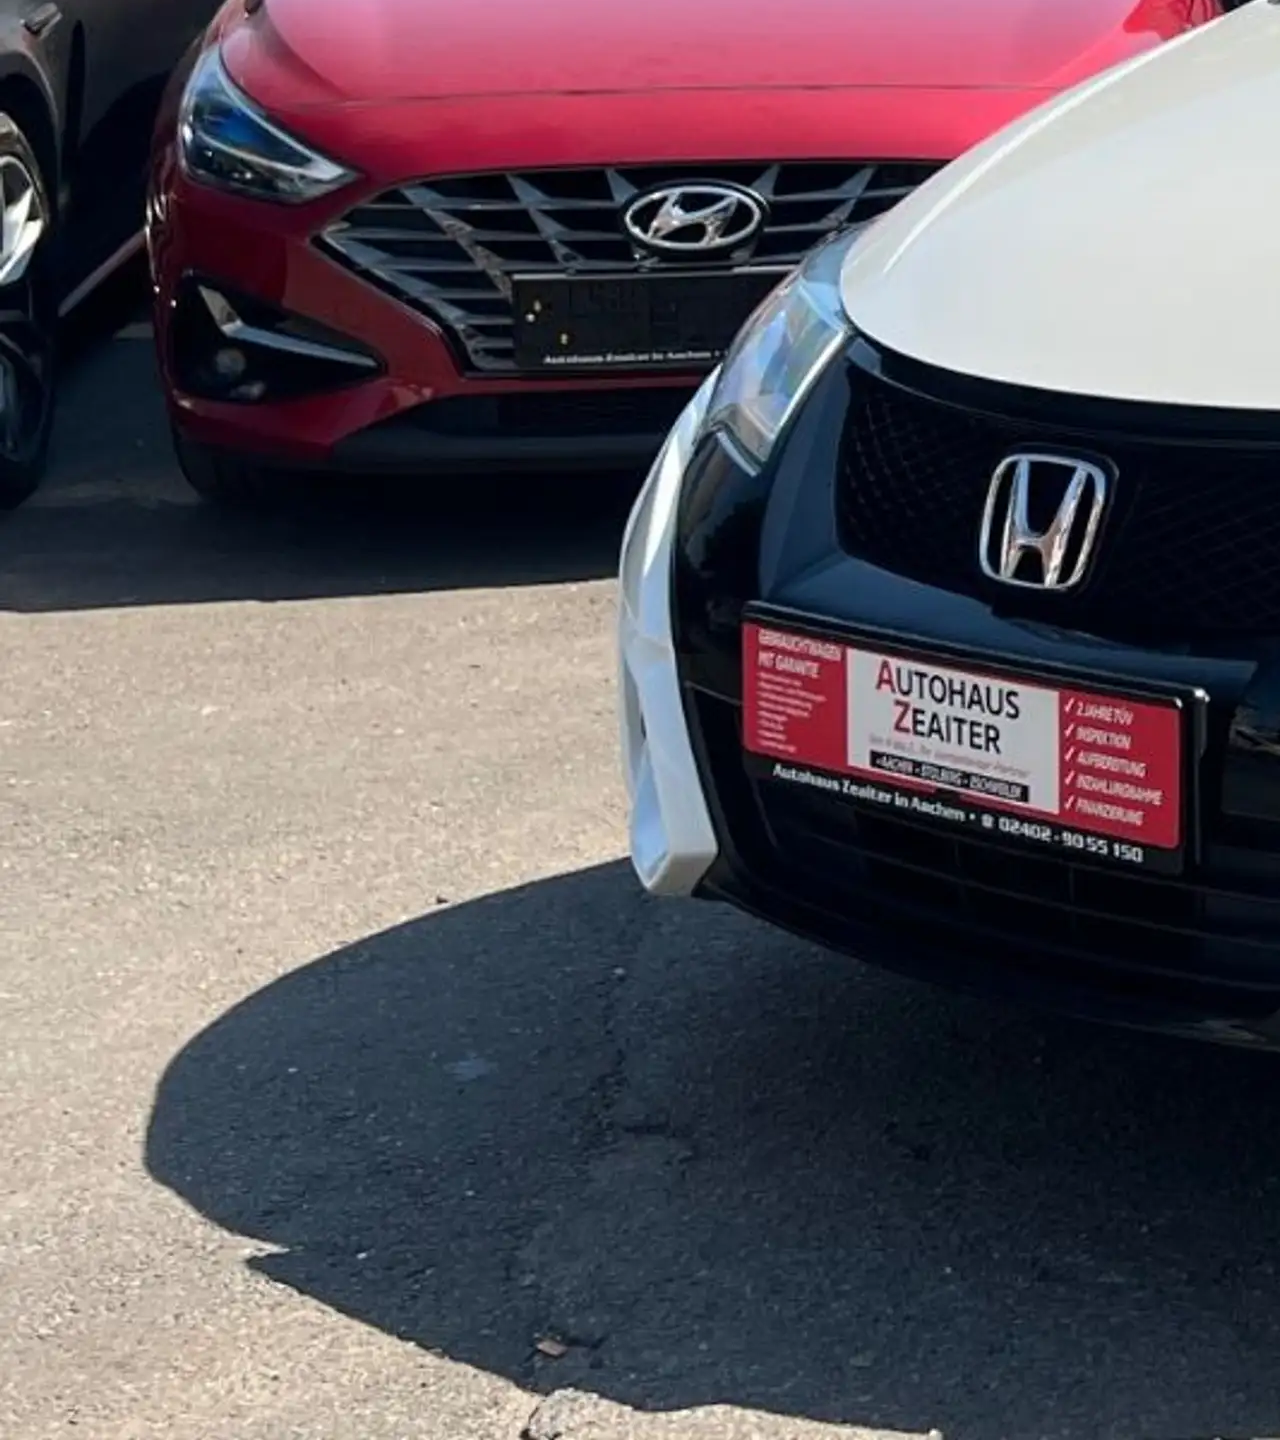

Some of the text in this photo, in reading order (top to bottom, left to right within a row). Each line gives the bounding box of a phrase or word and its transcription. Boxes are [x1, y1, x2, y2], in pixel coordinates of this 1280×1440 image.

[875, 659, 1020, 720] AUTOHAUS
[893, 699, 1002, 755] ZEAITER
[773, 763, 840, 792] Autohaus
[842, 779, 893, 804] Zeaiter
[895, 791, 908, 808] in
[910, 796, 966, 822] Aachen
[999, 816, 1051, 842] 02402
[1113, 841, 1144, 863] 150
